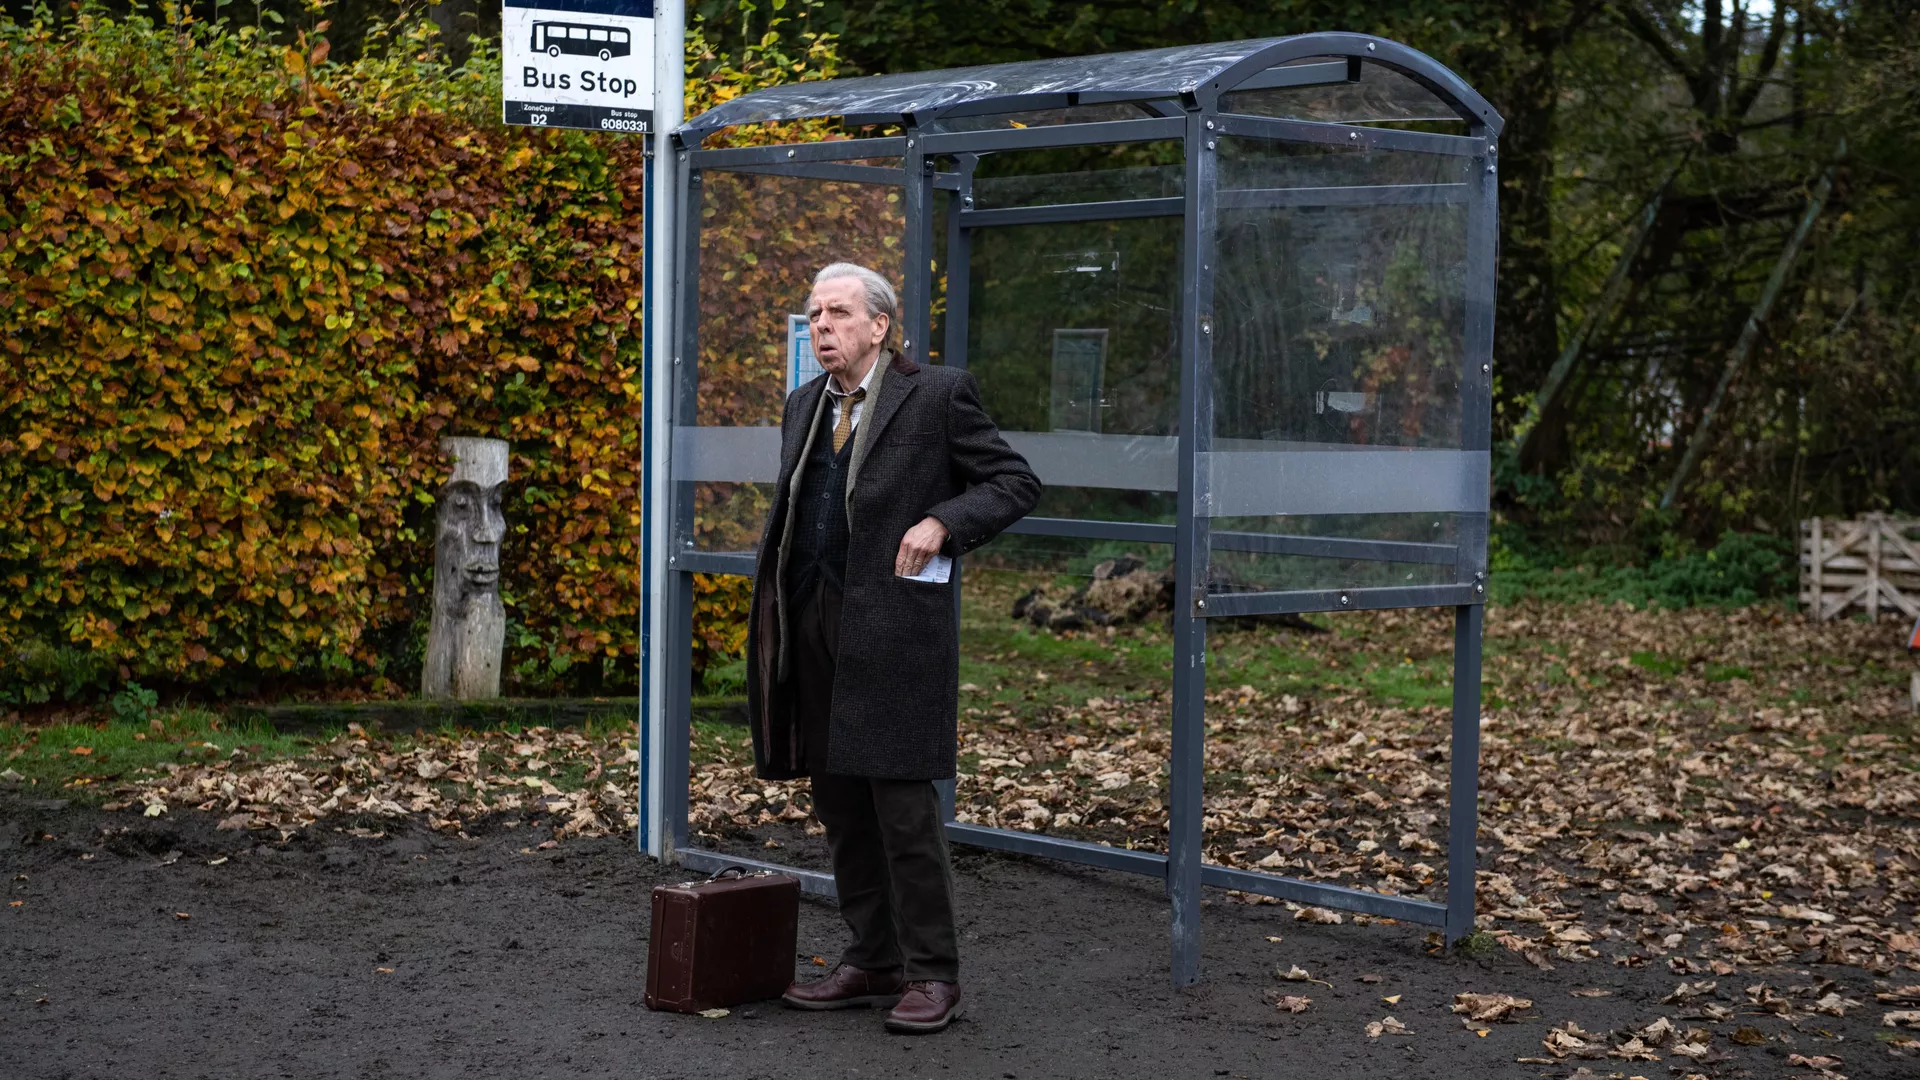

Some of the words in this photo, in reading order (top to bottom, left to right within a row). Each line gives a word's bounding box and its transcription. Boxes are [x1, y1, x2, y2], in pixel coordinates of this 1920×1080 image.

[524, 66, 571, 90] Bus
[580, 70, 637, 98] Stop
[523, 104, 555, 113] ZoneCard
[530, 114, 547, 125] D2
[624, 110, 638, 119] stop
[601, 119, 647, 131] 6080331
